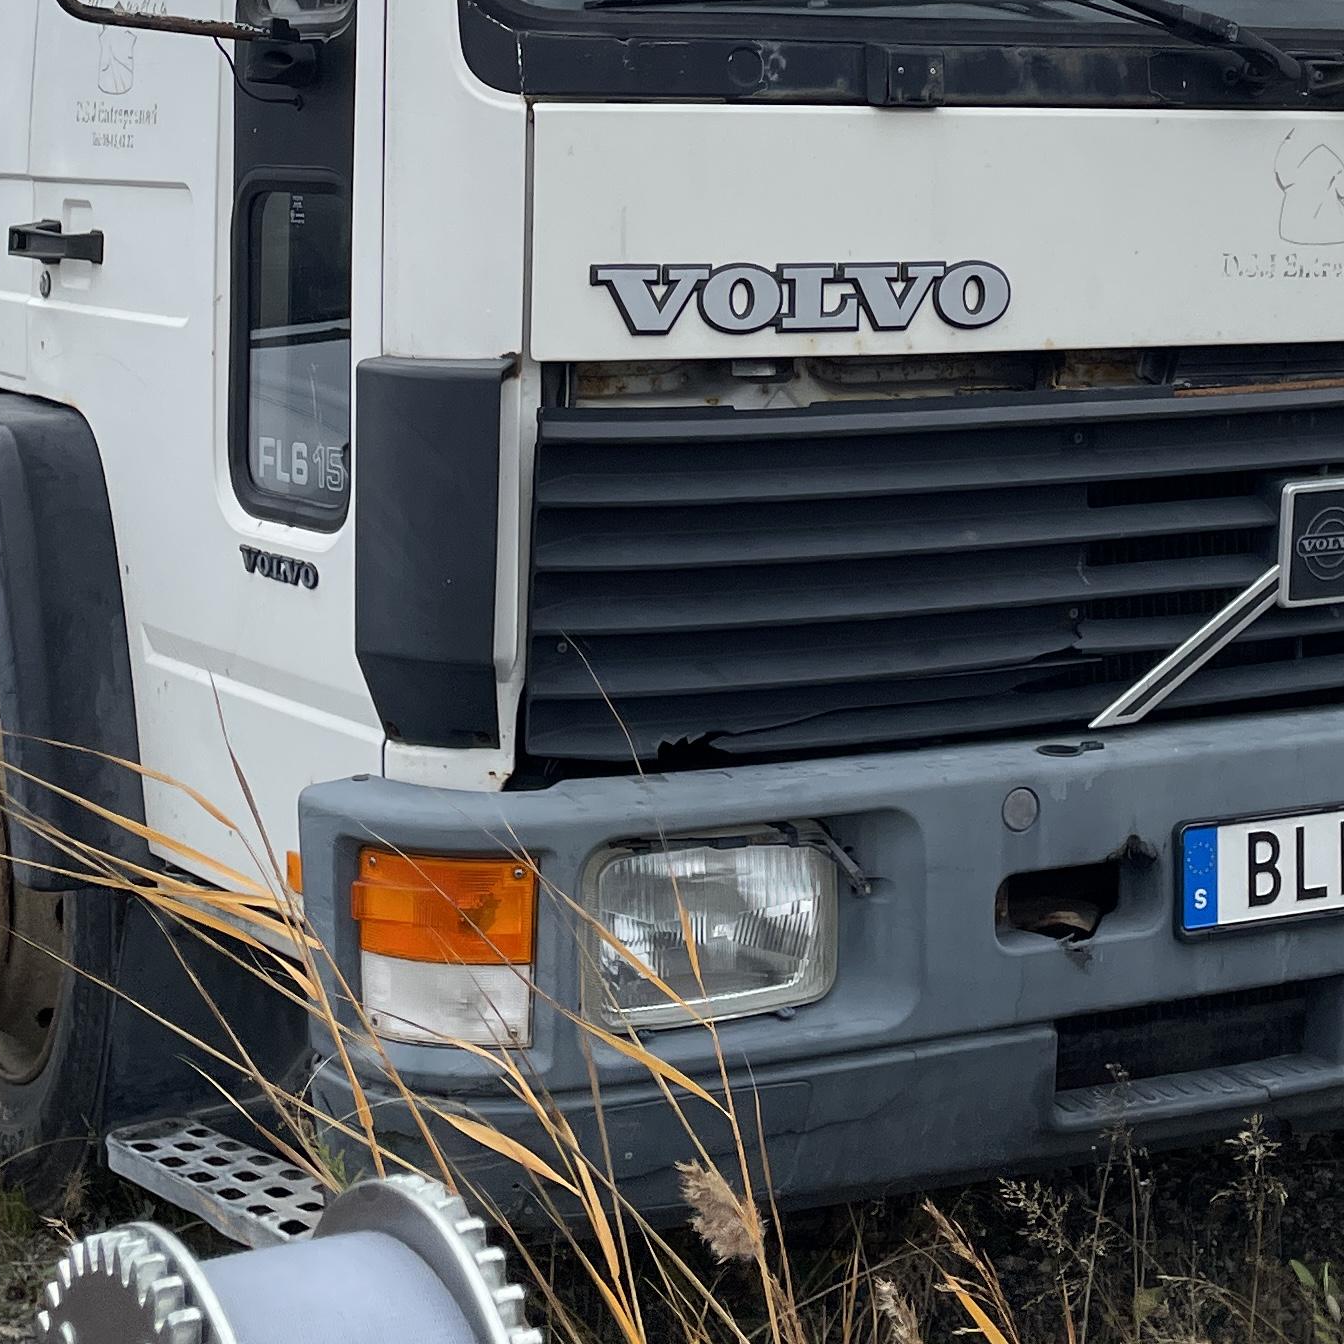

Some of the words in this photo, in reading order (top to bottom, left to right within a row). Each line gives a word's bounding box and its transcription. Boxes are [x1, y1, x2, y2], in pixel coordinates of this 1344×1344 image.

[590, 260, 1011, 335] VOLVO
[259, 436, 308, 485] FL6
[239, 544, 319, 590] VOLVO
[1194, 888, 1207, 910] S
